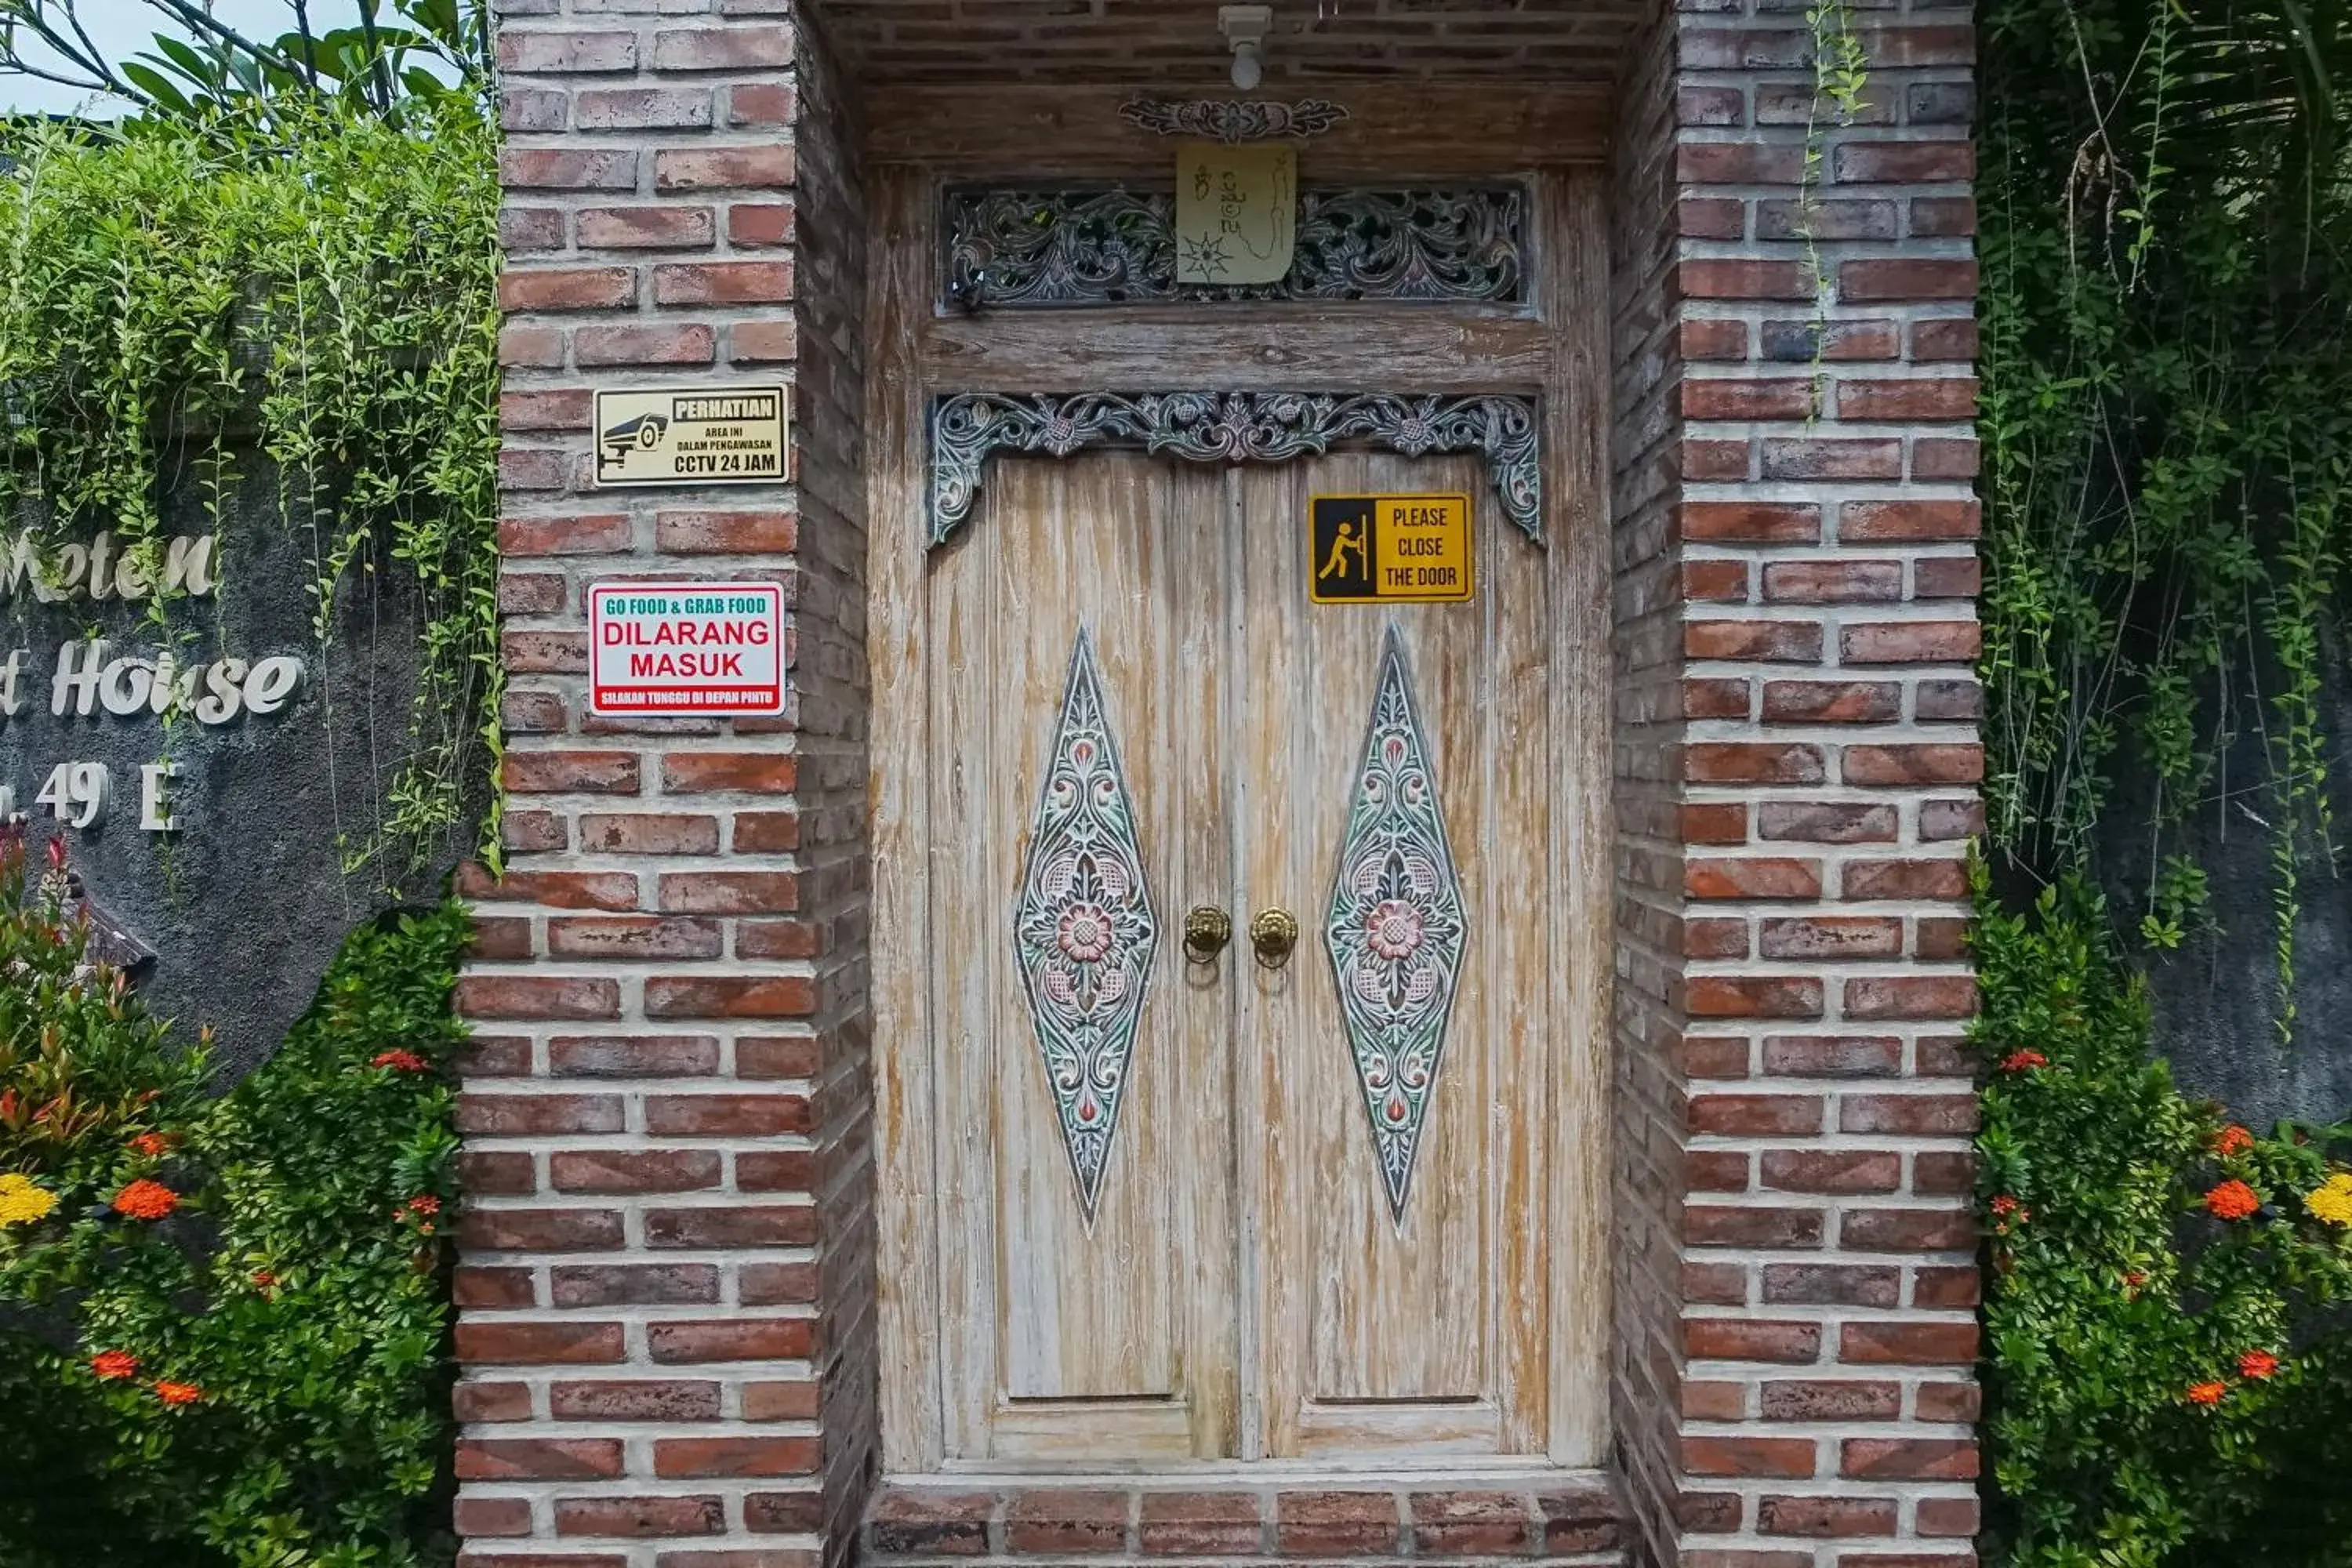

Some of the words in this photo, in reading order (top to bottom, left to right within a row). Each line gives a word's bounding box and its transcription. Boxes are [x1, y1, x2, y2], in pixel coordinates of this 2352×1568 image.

[676, 399, 772, 419] PERHATIAN
[706, 427, 728, 437] AREA
[730, 426, 742, 437] INI
[677, 441, 708, 451] DALAM
[710, 440, 772, 450] PENGAWASAN
[675, 456, 716, 472] CCTV
[721, 455, 740, 471] 24
[745, 454, 775, 470] JAM
[1393, 508, 1447, 527] PLEASE
[1398, 537, 1443, 556] CLOSE
[1385, 567, 1414, 586] THE
[1417, 567, 1457, 586] DOOR
[606, 599, 626, 615] GO
[630, 598, 667, 614] FOOD
[671, 601, 681, 613] &
[685, 598, 724, 614] GRAB
[728, 598, 766, 613] FOOD
[604, 621, 769, 645] DILARANG
[630, 653, 742, 677] MASUK
[52, 640, 301, 724] House
[647, 691, 690, 704] TUNGGU
[705, 691, 739, 704] DEPAN
[741, 691, 773, 704] PINTU
[34, 762, 105, 829] 49
[140, 764, 176, 829] E
